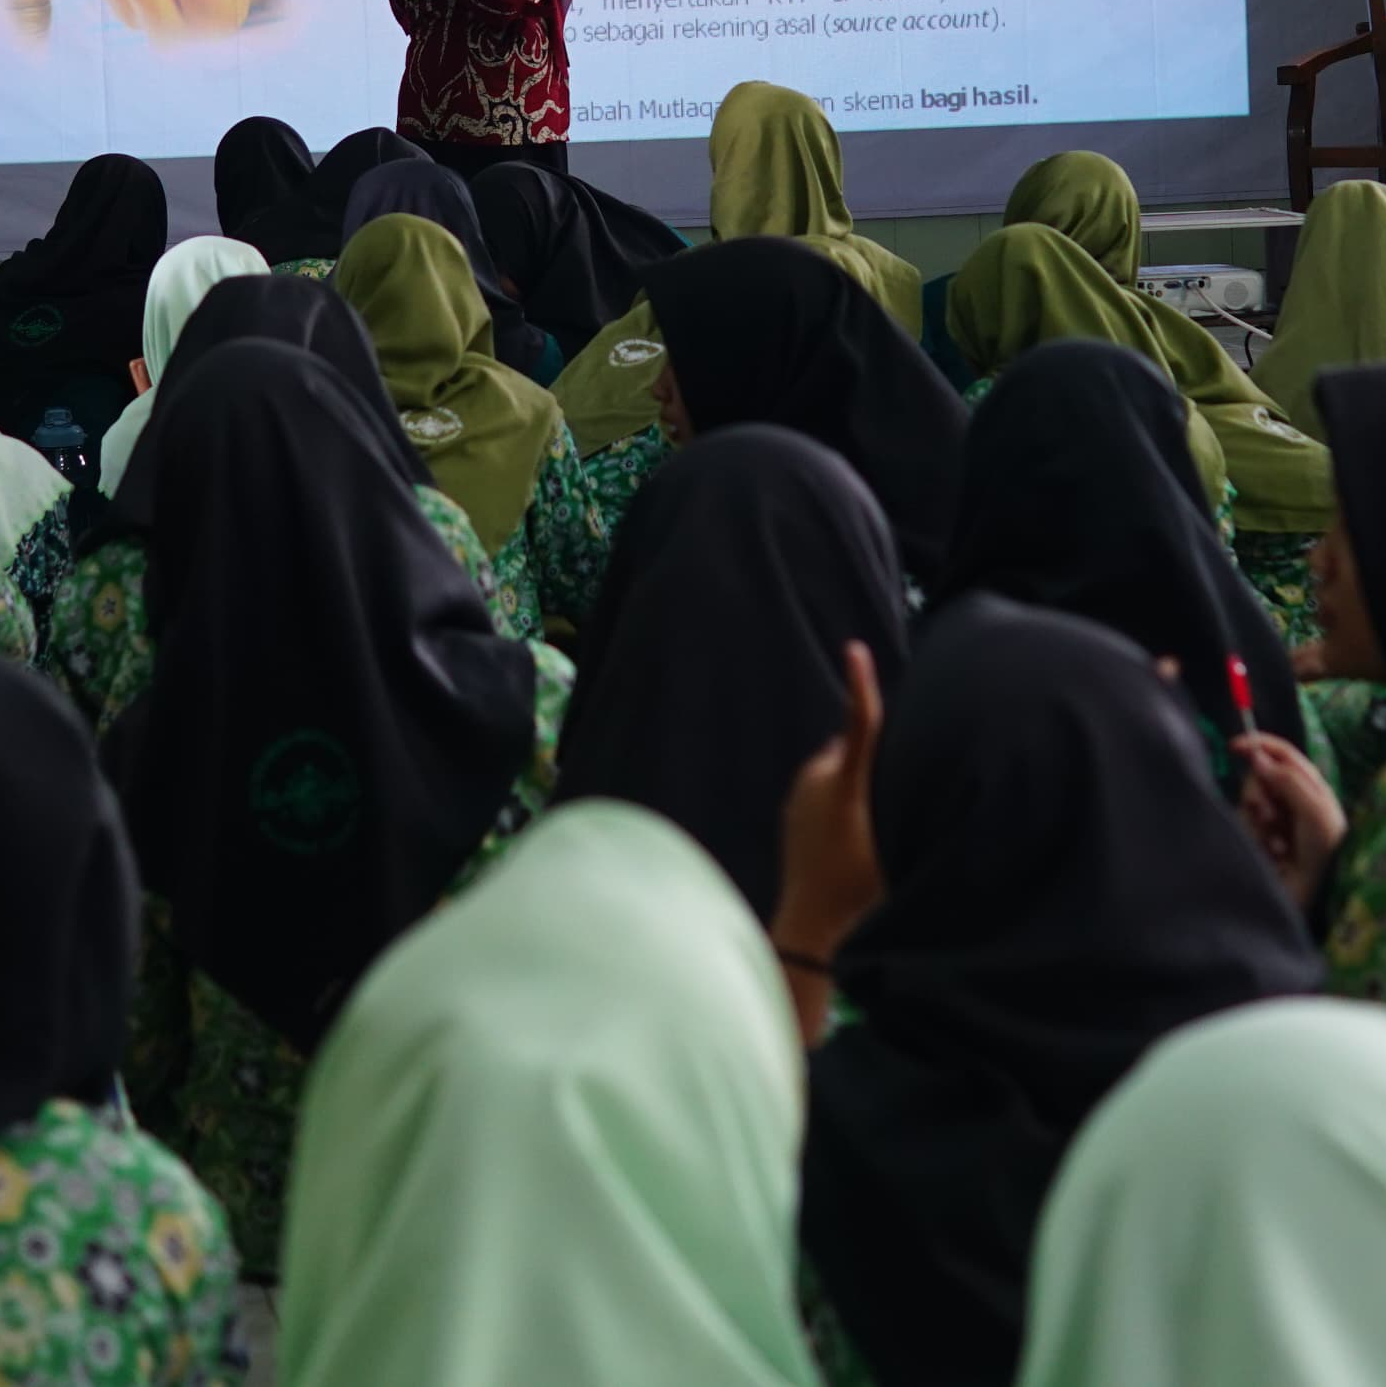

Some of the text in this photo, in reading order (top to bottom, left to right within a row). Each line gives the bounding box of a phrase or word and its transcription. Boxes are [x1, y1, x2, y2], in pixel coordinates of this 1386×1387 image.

[582, 20, 664, 45] sebagai
[673, 15, 768, 41] rekening
[775, 15, 816, 36] asal
[823, 13, 897, 39] (source
[902, 7, 1006, 33] account).
[843, 91, 915, 113] skema
[921, 88, 966, 113] bagi
[972, 85, 1039, 107] hasil.
